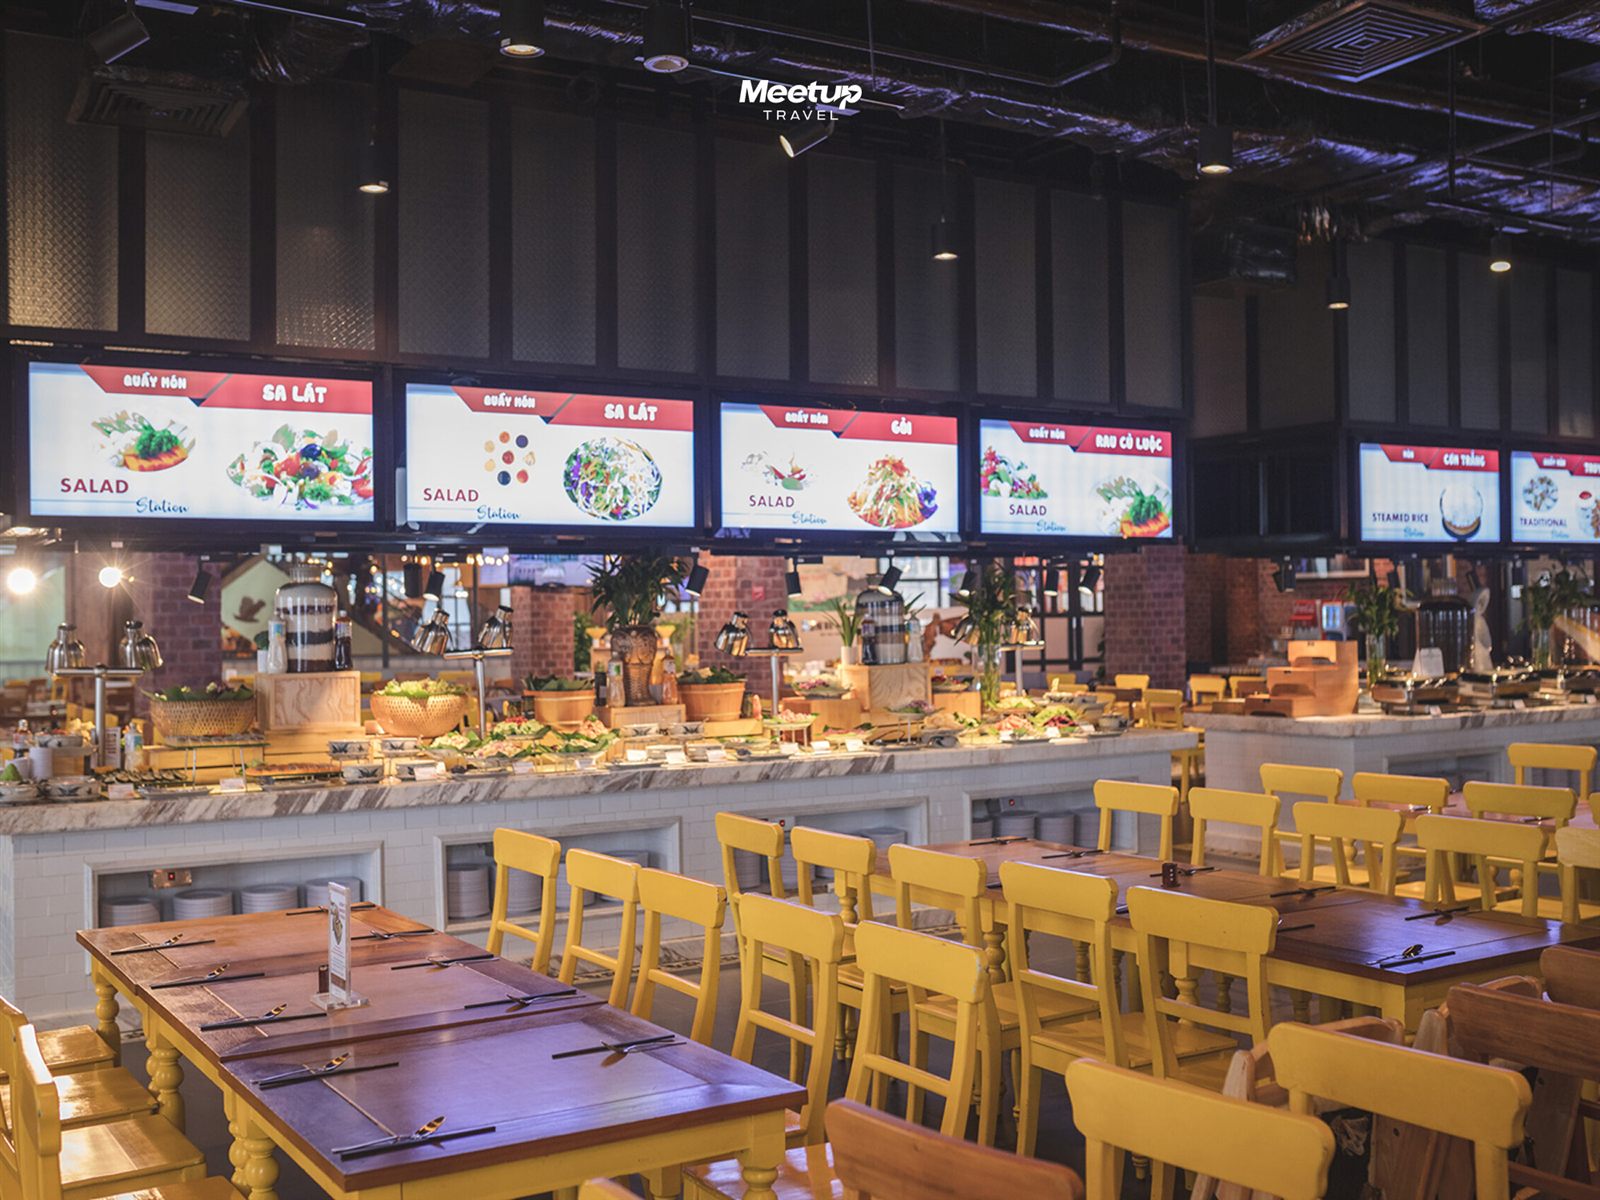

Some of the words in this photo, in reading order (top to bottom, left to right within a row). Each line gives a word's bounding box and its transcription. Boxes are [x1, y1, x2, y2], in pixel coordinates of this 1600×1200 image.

[160, 374, 187, 389] MÓN
[262, 383, 287, 402] SA
[292, 382, 328, 404] LÁT
[604, 403, 625, 420] SA
[628, 402, 658, 422] LÁT
[1096, 435, 1116, 449] RAU
[60, 477, 129, 494] SALAD
[423, 488, 479, 502] SALAD
[749, 495, 795, 508] SALAD
[136, 496, 189, 514] Station
[476, 504, 520, 520] Station
[1009, 503, 1047, 516] SALAD
[1372, 512, 1409, 523] STEAMED
[1411, 513, 1429, 523] RICE
[1520, 517, 1568, 527] TRADITIONAL
